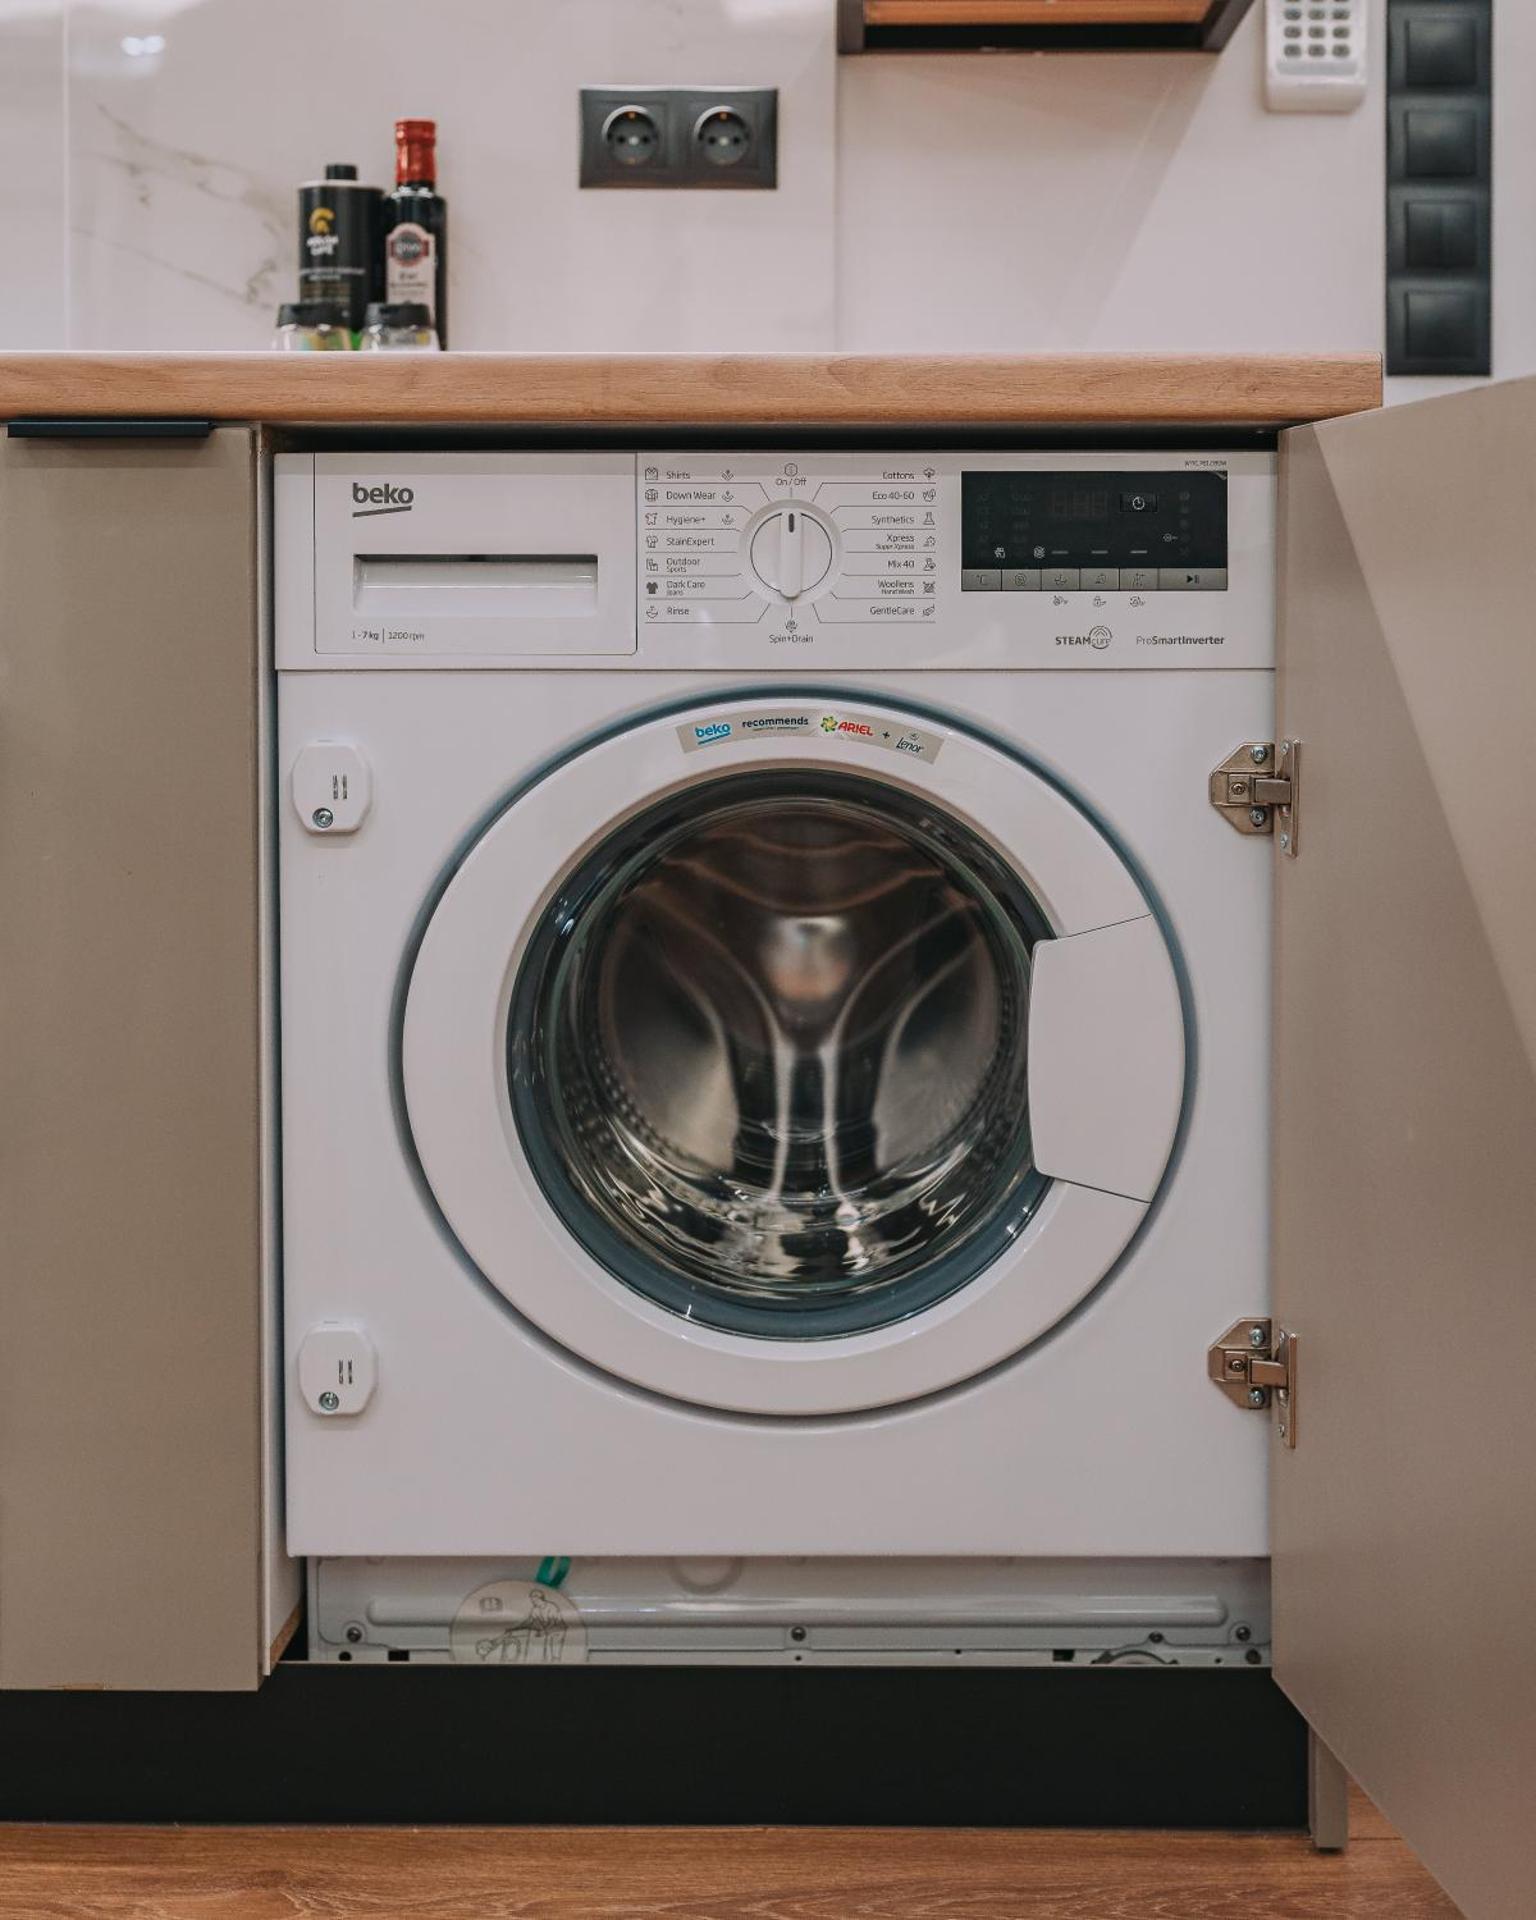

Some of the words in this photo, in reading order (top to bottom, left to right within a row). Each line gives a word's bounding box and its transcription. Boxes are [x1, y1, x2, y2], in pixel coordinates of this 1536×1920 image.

[666, 470, 691, 480] Shirts
[882, 471, 915, 480] Cottons
[775, 477, 788, 486] On
[794, 477, 807, 486] Off
[352, 482, 414, 504] beko
[666, 490, 692, 500] Down
[693, 490, 717, 500] Wear
[872, 490, 887, 500] Eco
[888, 490, 915, 500] 40-60
[666, 514, 706, 526] Hygiene+
[871, 514, 915, 526] Synthetics
[666, 536, 715, 549] StainExpert
[886, 534, 915, 544] Xpress
[666, 557, 701, 566] Outdoor
[887, 559, 902, 569] Mix
[903, 559, 915, 569] 40
[666, 579, 686, 589] Dark
[687, 579, 706, 589] Care
[666, 606, 690, 616] Rinse
[869, 606, 915, 616] GentleCare
[1136, 634, 1225, 646] ProSmartInverter
[695, 723, 731, 738] beko
[741, 716, 809, 728] recommends
[838, 721, 873, 736] ARIEL
[896, 736, 925, 753] Lenor
